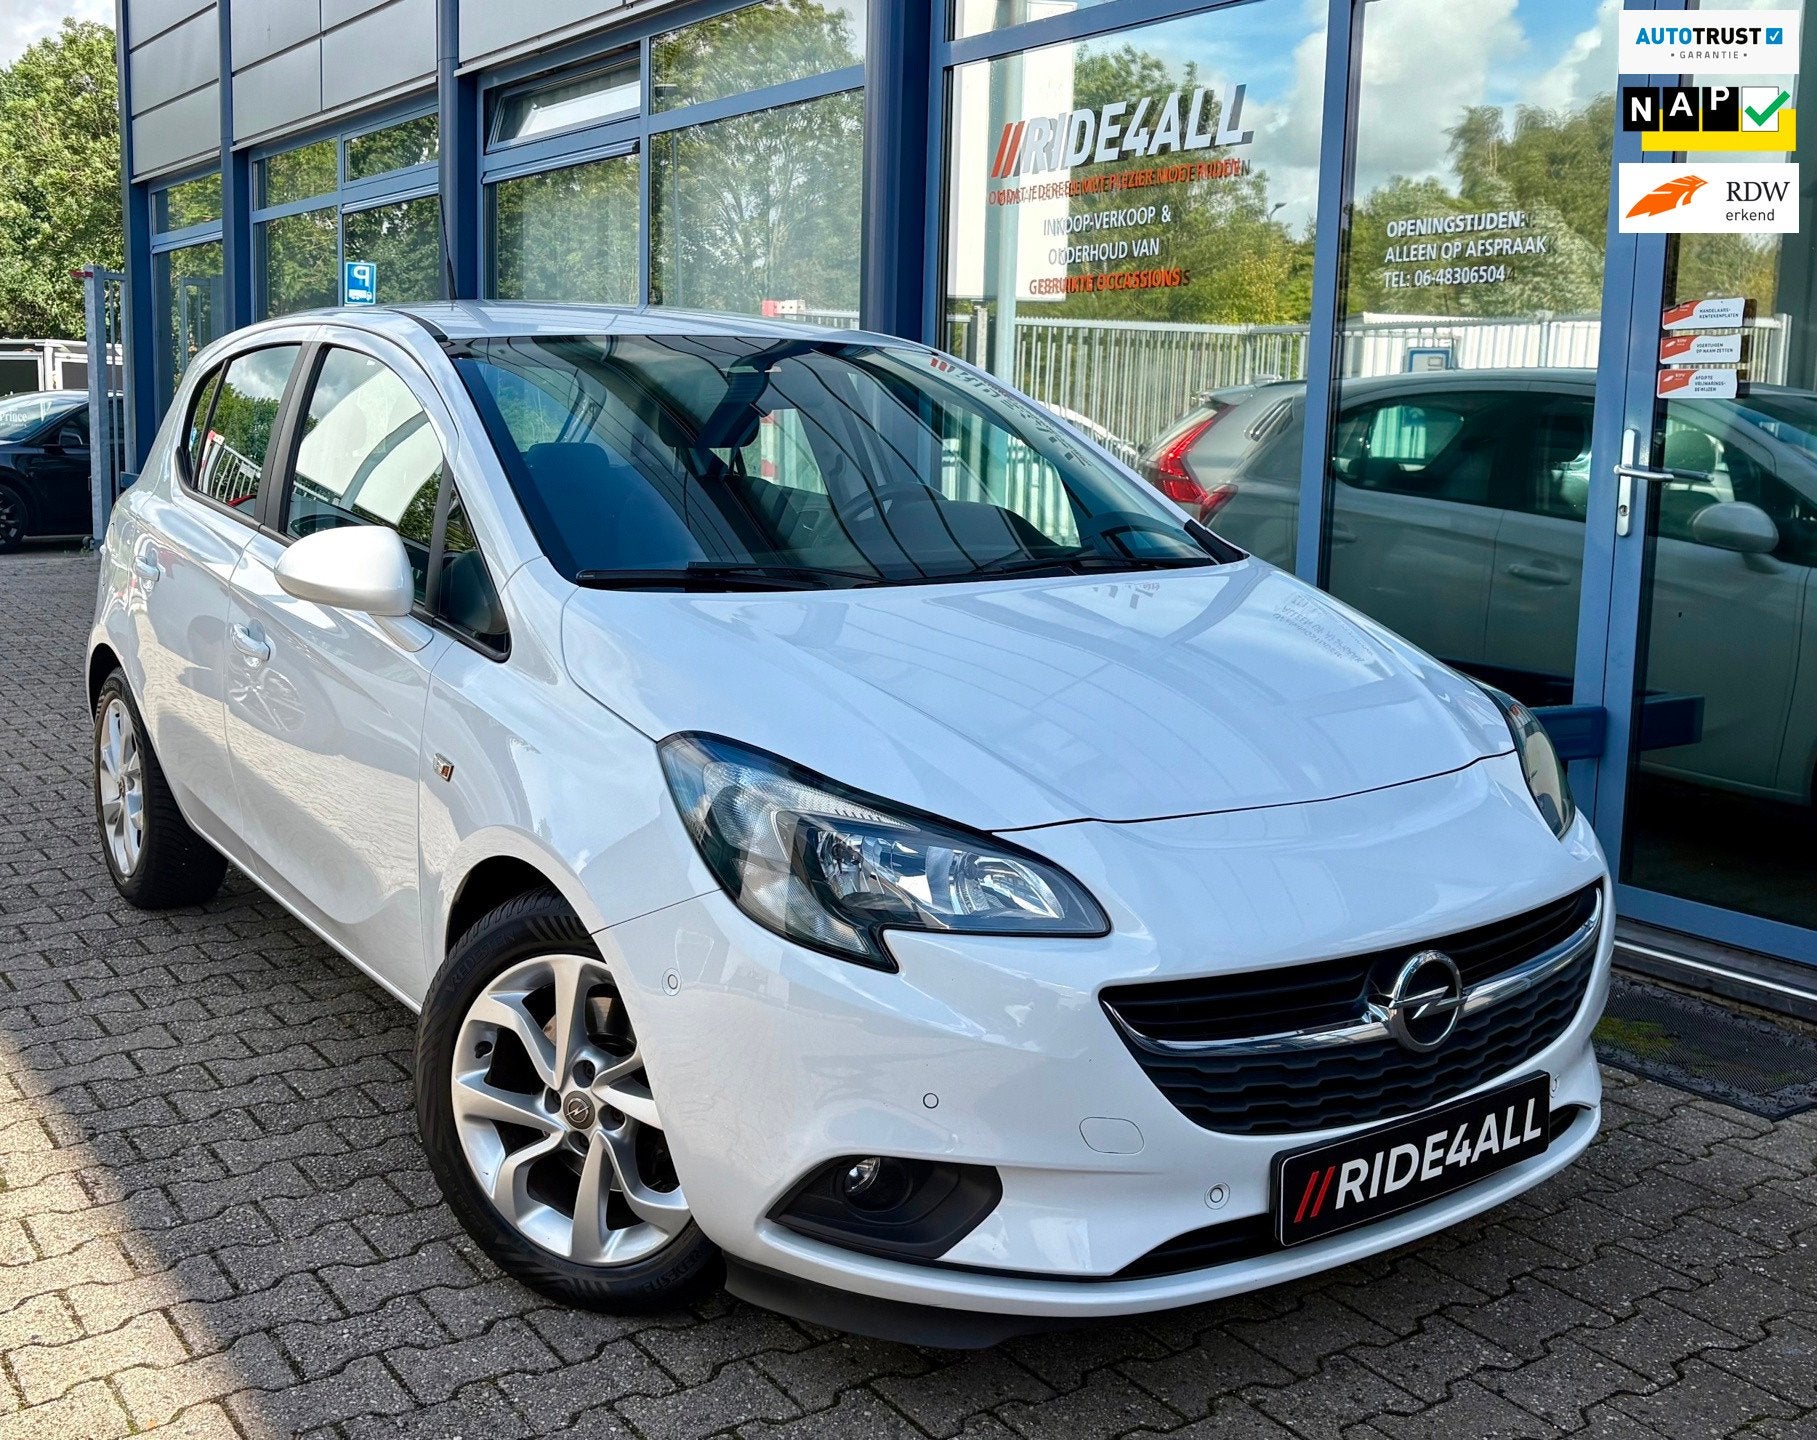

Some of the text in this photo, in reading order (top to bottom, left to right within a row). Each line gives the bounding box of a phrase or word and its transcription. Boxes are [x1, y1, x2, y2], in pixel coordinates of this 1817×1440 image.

[1160, 203, 1172, 223] &
[1386, 210, 1526, 238] OPENINGSTIJDEN:
[1131, 236, 1160, 258] VAN
[1384, 235, 1548, 263] ALLEEN OP AFSPRAAK
[1384, 264, 1506, 289] TEL: 06-48306504
